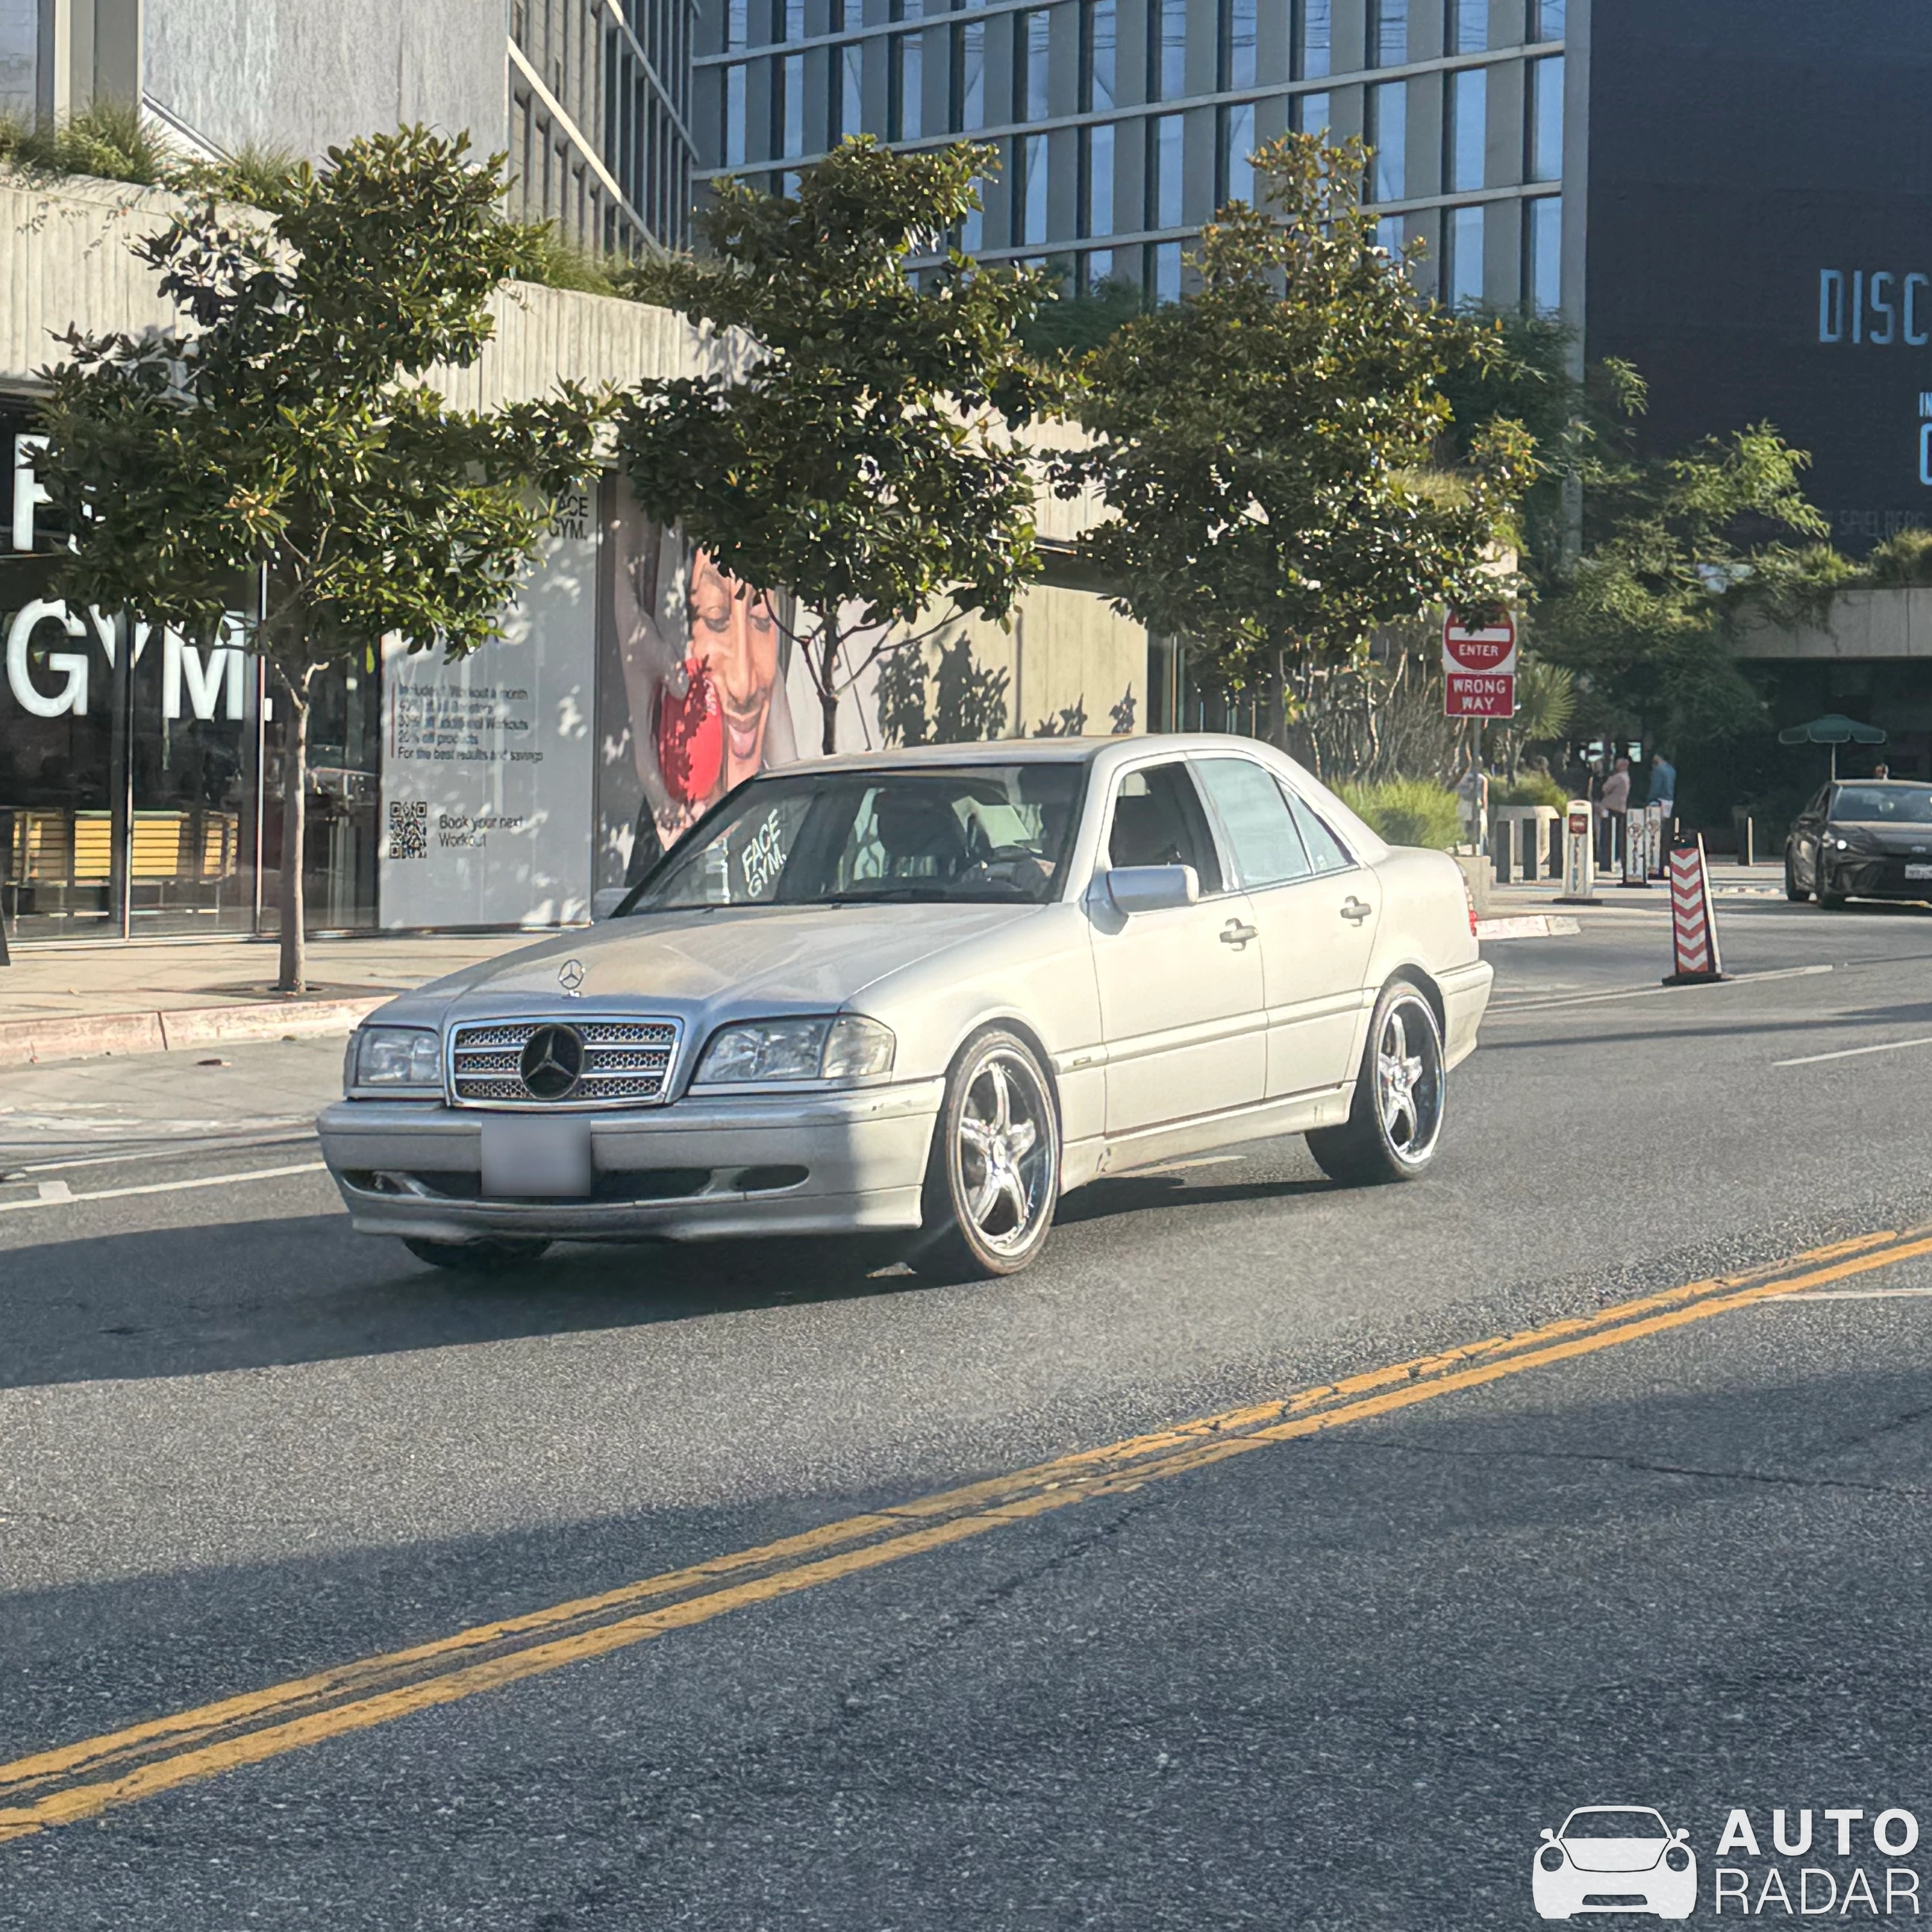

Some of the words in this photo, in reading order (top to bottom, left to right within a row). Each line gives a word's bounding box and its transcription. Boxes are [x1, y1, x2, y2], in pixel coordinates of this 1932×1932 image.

[551, 494, 589, 517] ACE
[1458, 644, 1499, 657] ENTER
[1452, 678, 1506, 694] WRONG
[1461, 696, 1495, 711] WAY
[398, 746, 414, 759] For
[439, 814, 469, 829] Book
[469, 817, 497, 833] your
[742, 808, 781, 883] FACE
